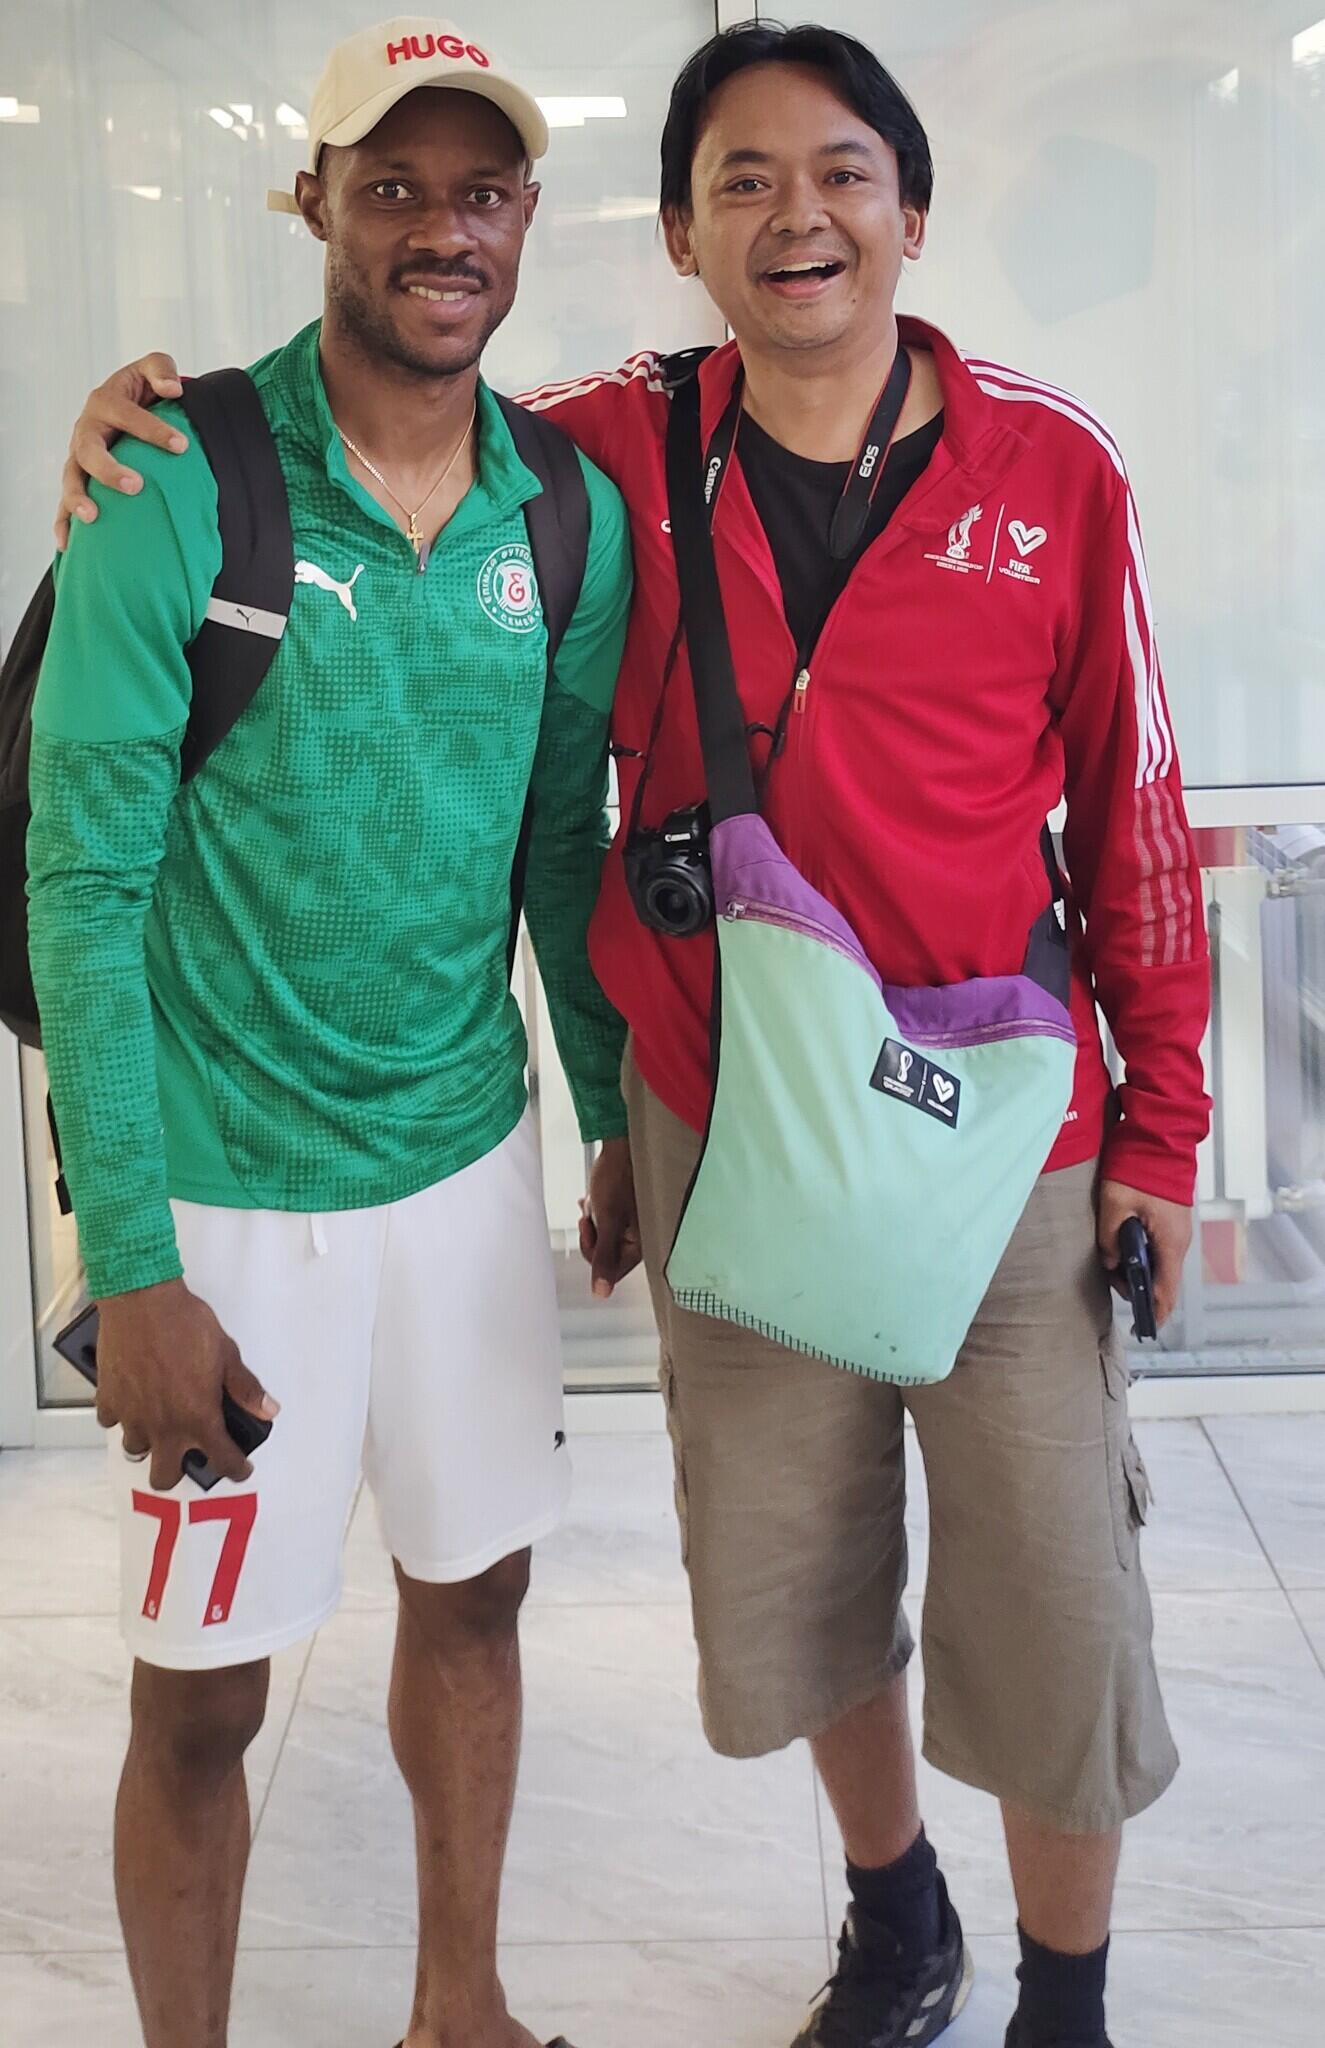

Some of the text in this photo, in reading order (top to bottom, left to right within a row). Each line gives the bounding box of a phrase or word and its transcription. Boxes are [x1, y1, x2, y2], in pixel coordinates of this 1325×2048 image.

[386, 34, 490, 67] HUGO
[859, 444, 880, 478] EOS
[1009, 558, 1031, 576] FIFA
[131, 1488, 258, 1627] 77
